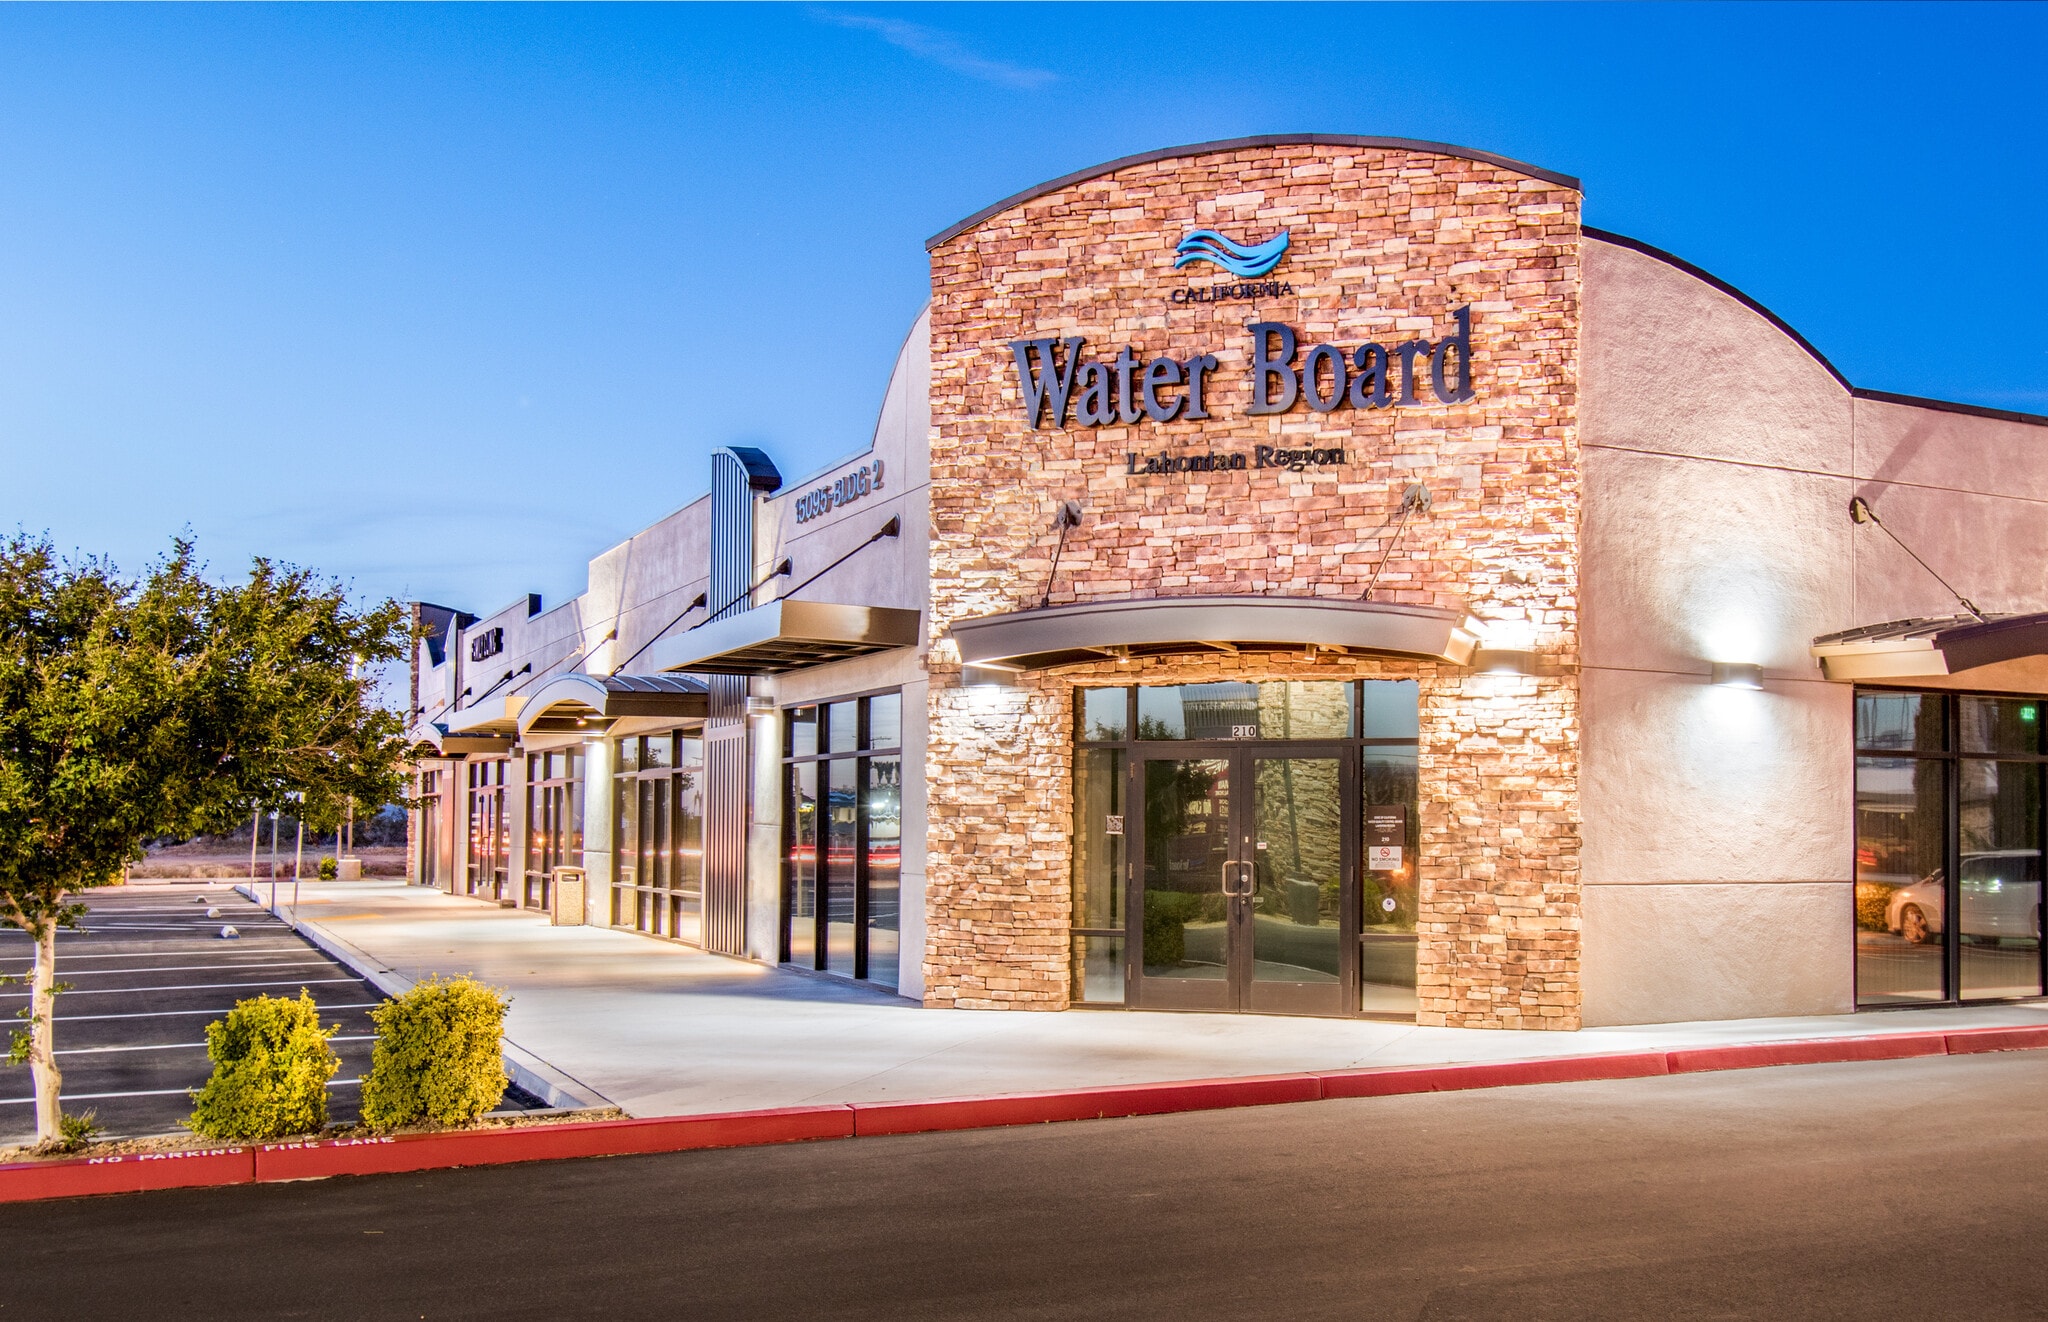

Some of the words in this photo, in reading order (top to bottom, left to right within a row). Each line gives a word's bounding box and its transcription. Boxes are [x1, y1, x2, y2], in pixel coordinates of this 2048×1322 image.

[1171, 280, 1295, 304] CALIFORNIA
[1008, 336, 1219, 430] Water
[1247, 304, 1477, 416] Board
[1127, 451, 1246, 475] Lahontan
[1254, 442, 1346, 472] Region
[795, 466, 870, 524] 15095-BLDG
[872, 459, 883, 490] 2
[1233, 726, 1256, 737] 210
[88, 1156, 122, 1165] NO
[139, 1147, 243, 1161] PARKING
[264, 1140, 320, 1152] FIRE
[334, 1135, 396, 1147] LANE
